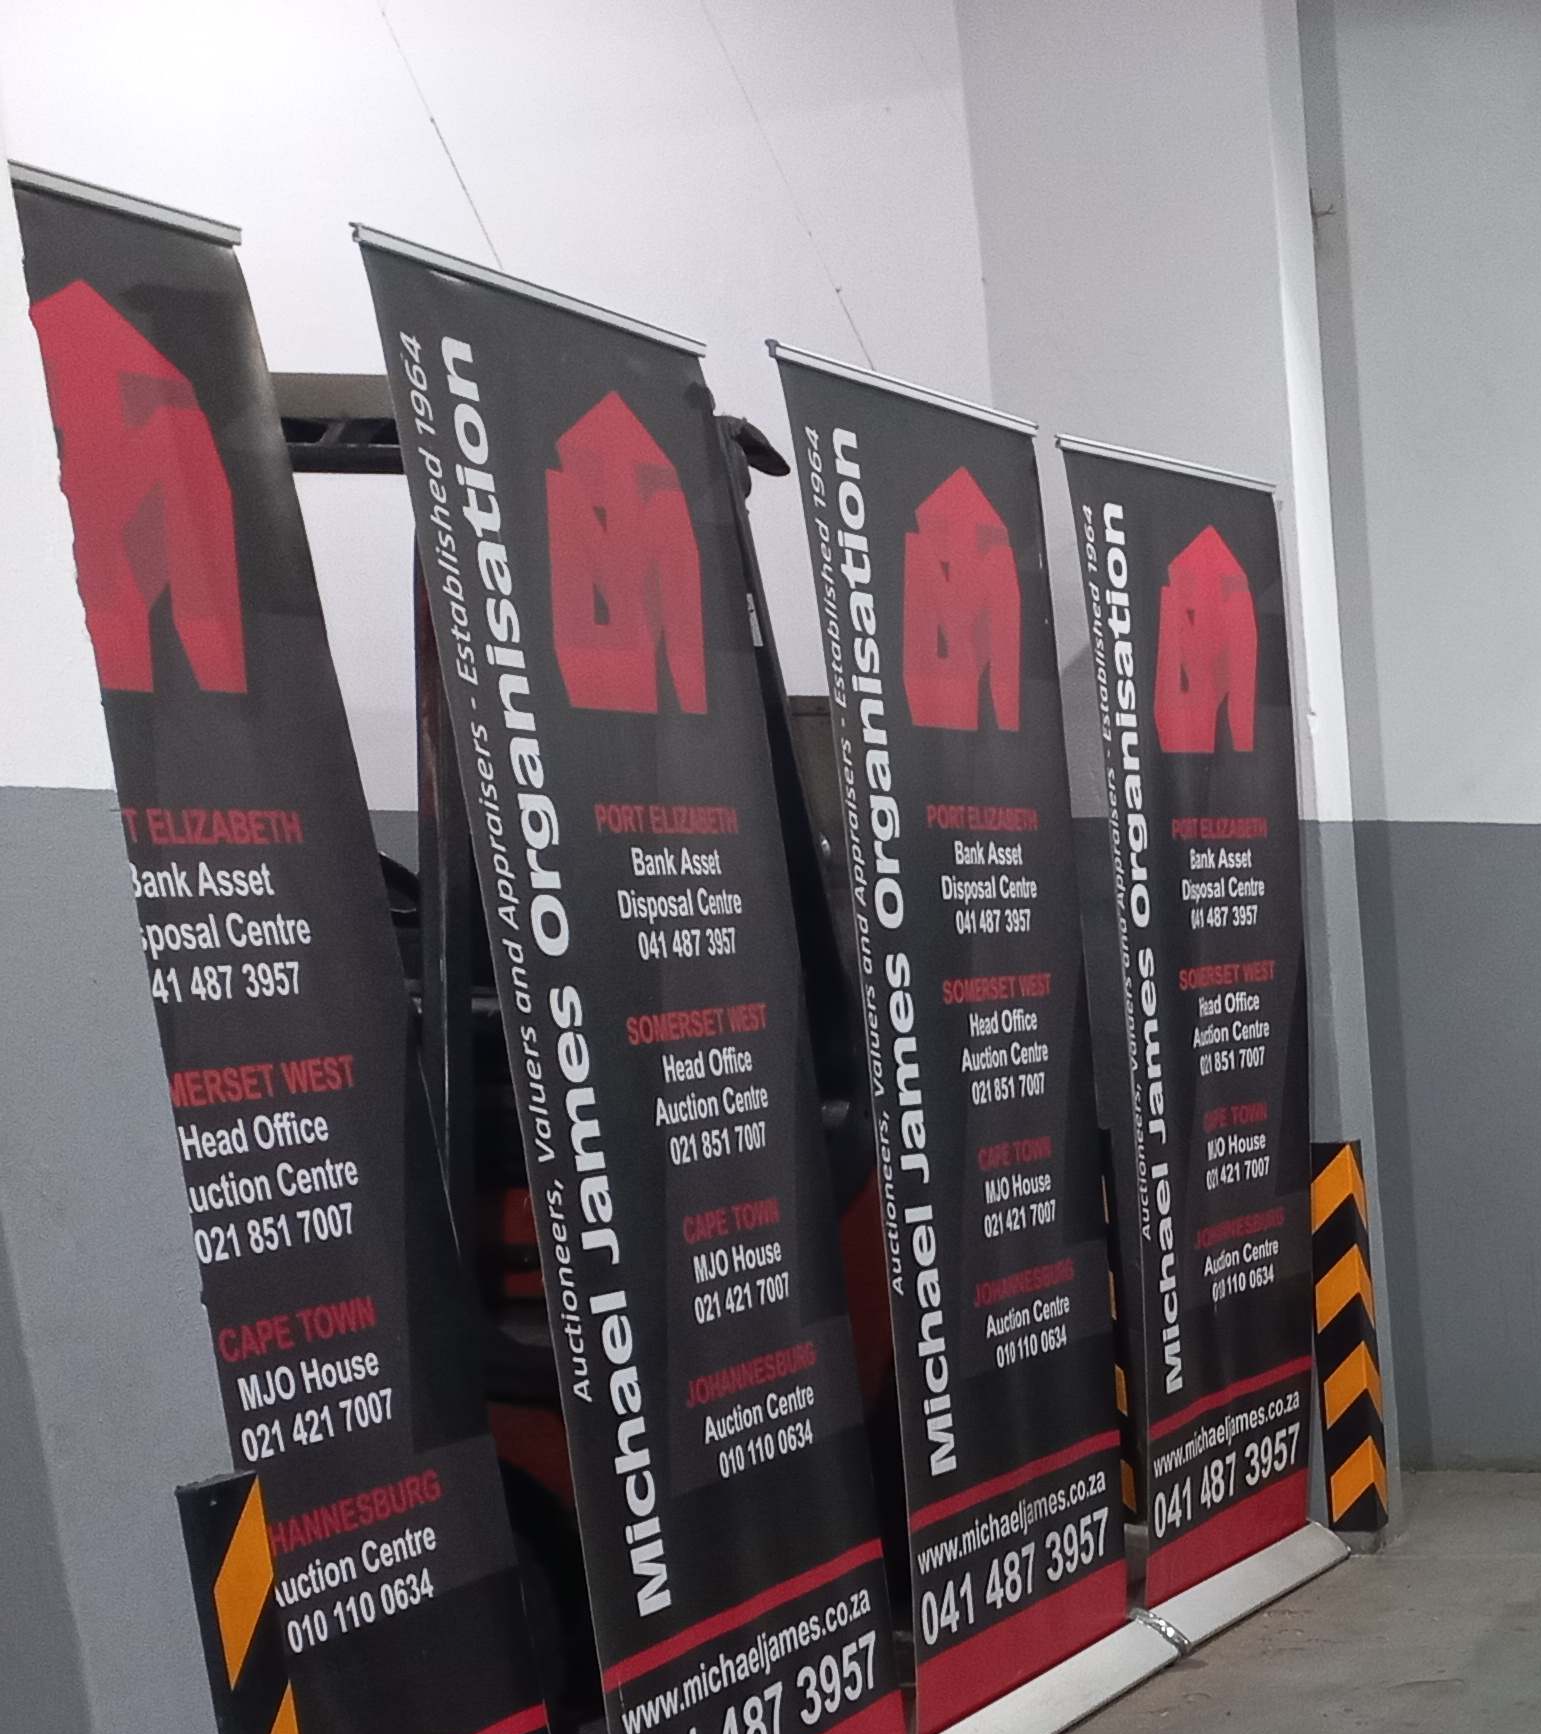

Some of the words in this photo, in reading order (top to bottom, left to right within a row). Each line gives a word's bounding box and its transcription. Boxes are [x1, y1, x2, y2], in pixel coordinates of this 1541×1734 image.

[400, 332, 437, 436] 1964
[805, 426, 826, 508] 1964
[1082, 504, 1098, 573] 1964
[418, 447, 479, 686] Established
[815, 518, 847, 708] Established
[441, 336, 569, 957] Organisation
[833, 427, 904, 929] Organisation
[1103, 501, 1150, 928] Organisation
[147, 808, 303, 844] ELIZABETH
[471, 721, 520, 930] Appraisers
[595, 804, 644, 833] PORT
[841, 739, 867, 907] Appraisers
[198, 861, 275, 896] Asset
[631, 847, 678, 876] Bank
[681, 847, 722, 875] Asset
[954, 840, 985, 865] Bank
[988, 841, 1023, 865] Asset
[1218, 848, 1252, 868] Asset
[617, 889, 694, 925] Disposal
[697, 887, 742, 916] Centre
[941, 875, 996, 905] Disposal
[999, 874, 1038, 898] Centre
[1228, 876, 1264, 897] Centre
[225, 912, 312, 948] Centre
[956, 910, 977, 934] 041
[979, 909, 1000, 933] 487
[1004, 908, 1031, 932] 3957
[1207, 906, 1228, 928] 487
[1232, 904, 1258, 926] 3957
[638, 931, 667, 960] 041
[673, 929, 700, 958] 487
[706, 927, 736, 956] 3957
[857, 913, 873, 975] and
[191, 965, 232, 1001] 487
[242, 961, 300, 998] 3957
[502, 939, 532, 1014] and
[1225, 991, 1260, 1013] Office
[626, 1008, 724, 1045] SOMERSET
[727, 1003, 768, 1032] WEST
[865, 984, 885, 1096] Valuers
[969, 1011, 998, 1037] Head
[1001, 1009, 1038, 1033] Office
[1138, 947, 1166, 1144] James
[1232, 1020, 1270, 1041] Centre
[281, 1054, 354, 1094] WEST
[662, 1051, 705, 1083] Head
[709, 1047, 752, 1076] Office
[885, 953, 930, 1184] James
[962, 1045, 1007, 1072] Auction
[1010, 1041, 1049, 1065] Centre
[1214, 1050, 1235, 1072] 851
[1239, 1045, 1265, 1068] 7007
[520, 1027, 555, 1163] Valuers
[656, 1093, 719, 1126] Auction
[723, 1085, 768, 1115] Centre
[971, 1080, 992, 1105] 021
[994, 1076, 1015, 1101] 851
[1019, 1072, 1045, 1097] 7007
[178, 1119, 248, 1161] Head
[253, 1111, 329, 1150] Office
[550, 985, 620, 1265] James
[670, 1134, 698, 1165] 021
[701, 1128, 731, 1159] 851
[735, 1121, 766, 1152] 7007
[1227, 1134, 1266, 1156] House
[188, 1171, 272, 1214] uction
[276, 1158, 359, 1197] Centre
[1220, 1162, 1240, 1185] 421
[1244, 1156, 1270, 1180] 7007
[683, 1209, 728, 1244] CAPE
[732, 1197, 780, 1231] TOWN
[878, 1110, 904, 1296] Auctioneers,
[984, 1211, 1004, 1238] 021
[1006, 1205, 1026, 1232] 421
[1030, 1200, 1056, 1227] 7007
[194, 1223, 241, 1264] 021
[247, 1214, 292, 1254] 851
[296, 1203, 353, 1243] 7007
[1242, 1239, 1279, 1263] Centre
[693, 1249, 729, 1284] MJO
[732, 1242, 782, 1273] House
[1151, 1162, 1183, 1394] Michael
[1226, 1272, 1246, 1295] 110
[1250, 1264, 1274, 1288] 0634
[545, 1178, 593, 1403] Auctioneers,
[694, 1291, 719, 1324] 021
[725, 1282, 753, 1314] 421
[757, 1272, 789, 1306] 7007
[986, 1307, 1030, 1339] Auction
[1033, 1296, 1070, 1323] Centre
[218, 1315, 295, 1362] CAPE
[297, 1296, 378, 1342] TOWN
[904, 1204, 957, 1476] Michael
[996, 1344, 1016, 1368] 010
[1017, 1334, 1038, 1360] 110
[1040, 1324, 1067, 1353] 0634
[237, 1366, 296, 1411] MJO
[300, 1352, 380, 1393] House
[241, 1420, 285, 1462] 021
[292, 1405, 335, 1446] 421
[339, 1388, 392, 1432] 7007
[704, 1402, 763, 1445] Auction
[767, 1385, 815, 1420] Centre
[1153, 1391, 1300, 1478] www.michaeljames.co.za
[589, 1291, 672, 1617] Michael
[719, 1447, 745, 1479] 010
[747, 1435, 774, 1465] 110
[777, 1419, 814, 1454] 0634
[1154, 1476, 1191, 1538] 041
[1200, 1451, 1236, 1509] 487
[1244, 1422, 1300, 1486] 3957
[917, 1471, 1106, 1575] www.michaeljames.co.za
[276, 1559, 357, 1607] uction
[361, 1526, 437, 1576] Centre
[922, 1572, 974, 1645] 041
[986, 1542, 1035, 1609] 487
[1046, 1507, 1109, 1581] 3957
[286, 1608, 328, 1654] 010
[332, 1591, 376, 1635] 110
[380, 1567, 434, 1613] 0634
[796, 1630, 876, 1725] 3957
